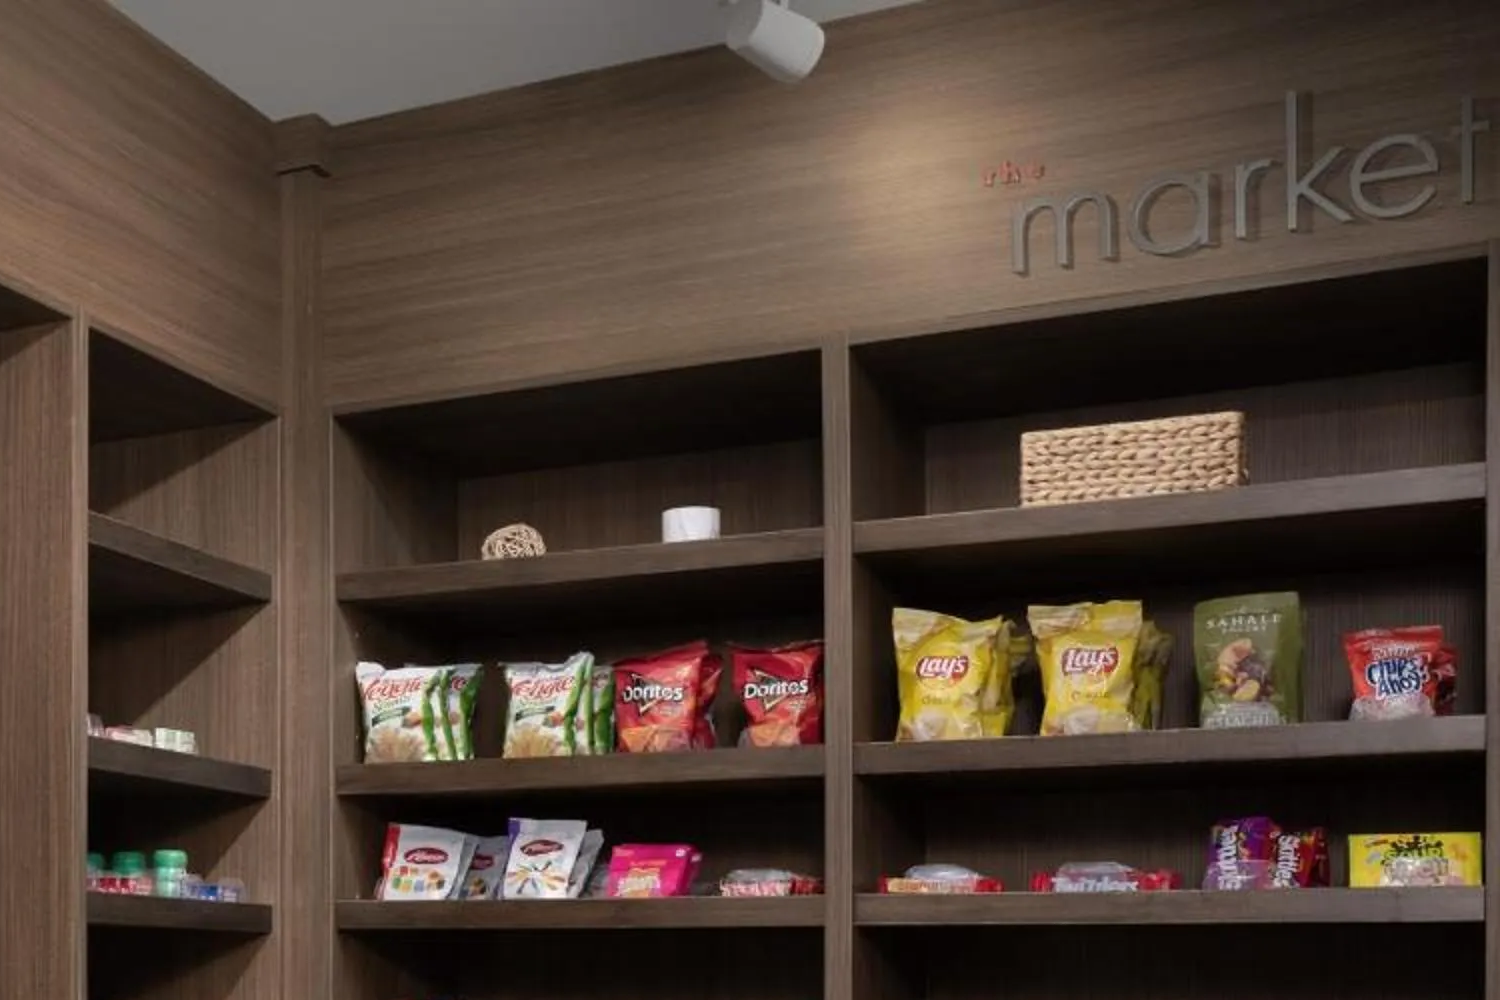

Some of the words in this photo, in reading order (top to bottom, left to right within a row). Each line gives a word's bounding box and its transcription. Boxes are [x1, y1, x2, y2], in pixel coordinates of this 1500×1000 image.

[1011, 89, 1491, 278] market
[1205, 612, 1283, 630] SAHALE
[917, 655, 968, 680] Lay's
[1064, 646, 1118, 675] Lay's
[1366, 656, 1420, 684] CHIPS
[623, 684, 684, 702] Doritos
[743, 678, 809, 700] Doritos
